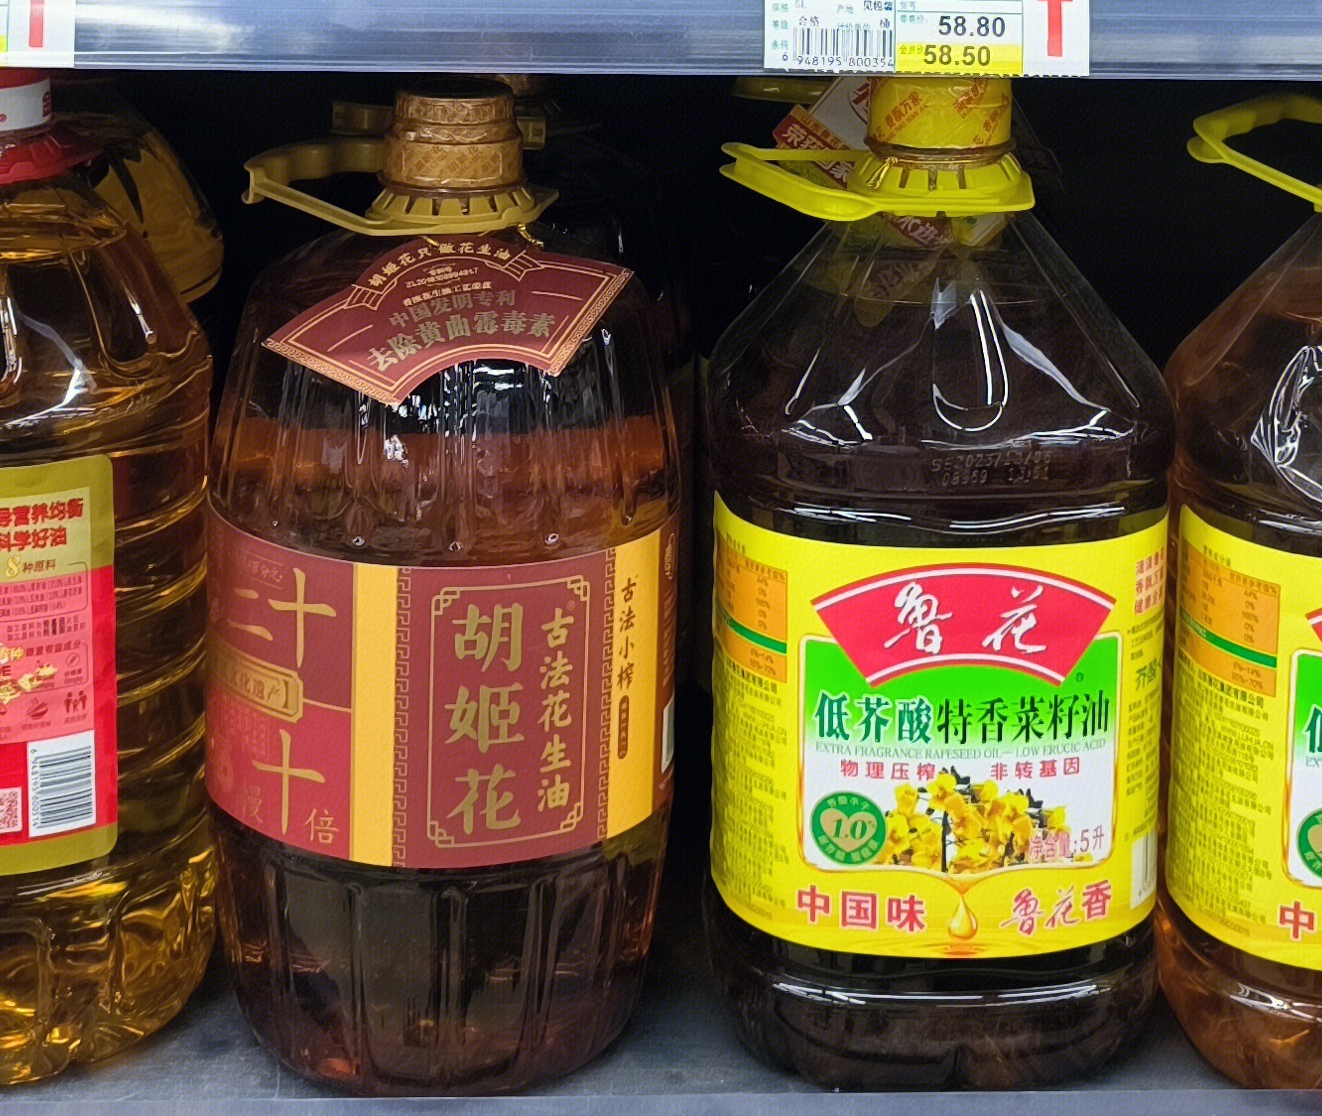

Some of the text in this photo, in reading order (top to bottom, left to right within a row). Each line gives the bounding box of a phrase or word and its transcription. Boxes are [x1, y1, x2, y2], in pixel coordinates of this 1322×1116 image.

[939, 16, 1006, 37] 58.80
[924, 45, 991, 66] 58.50
[369, 241, 511, 287] 胡姬花只做花生油
[389, 289, 516, 329] 中国发明专利
[367, 311, 555, 372] 去除黄曲霉毒素
[5, 555, 56, 577] 8 种原料
[616, 575, 637, 691] 古法小榨
[885, 582, 1047, 655] 鲁花
[445, 602, 525, 834] 胡姬花
[537, 606, 575, 813] 古法花生油
[814, 689, 1110, 745] 低芥酸特香菜籽油
[840, 757, 1080, 782] 物理压榨 非转基因
[1028, 826, 1105, 862] 净含量:5升
[797, 880, 1112, 934] 中国味 鲁花香
